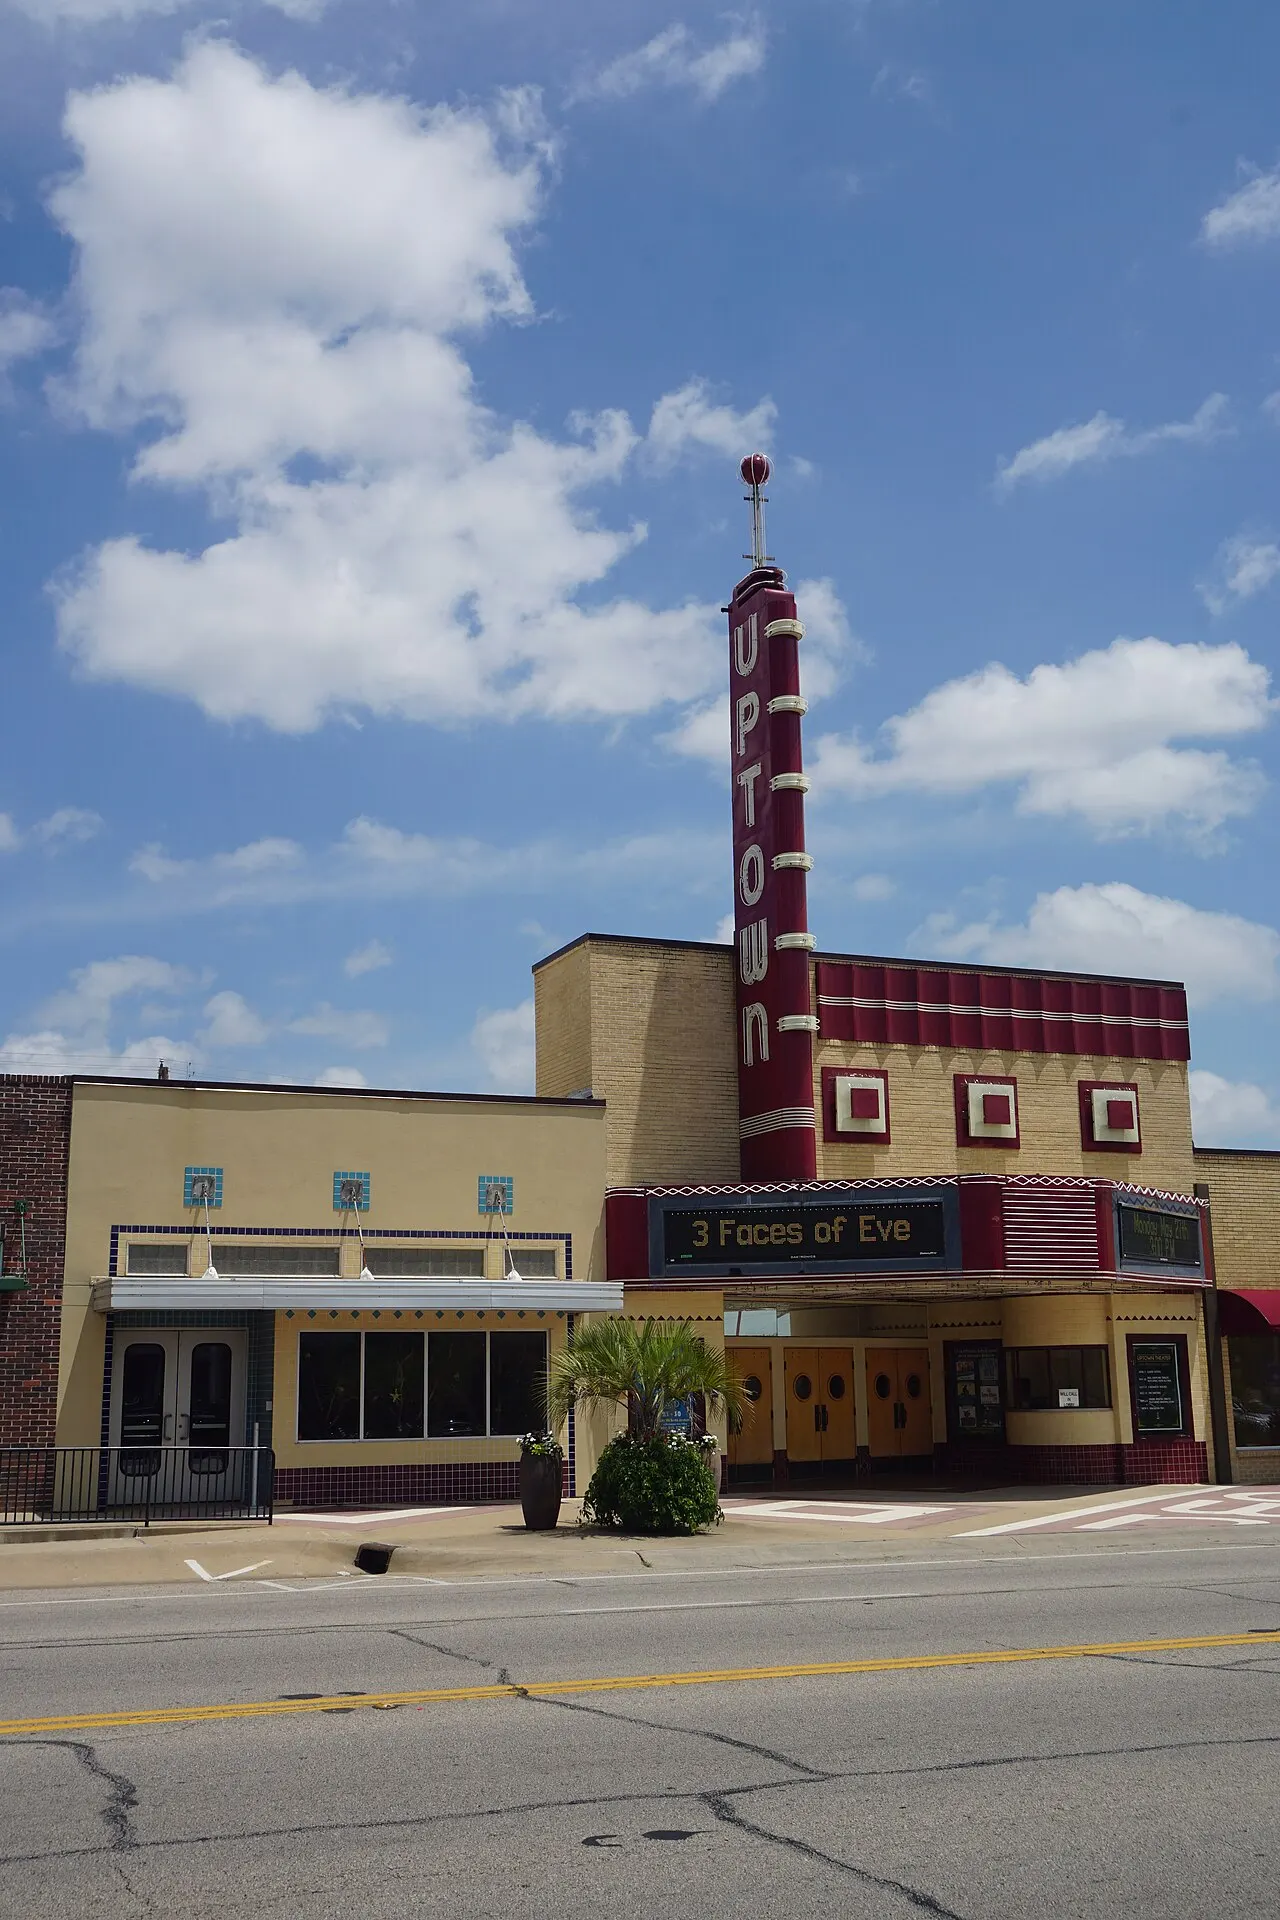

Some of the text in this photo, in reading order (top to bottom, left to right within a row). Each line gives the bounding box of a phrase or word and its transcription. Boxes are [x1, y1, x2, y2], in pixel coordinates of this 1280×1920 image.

[733, 612, 770, 1067] UPTOWN
[692, 1215, 911, 1247] 3 Faces of Eve
[1134, 1212, 1158, 1236] Monday
[1160, 1215, 1173, 1239] May
